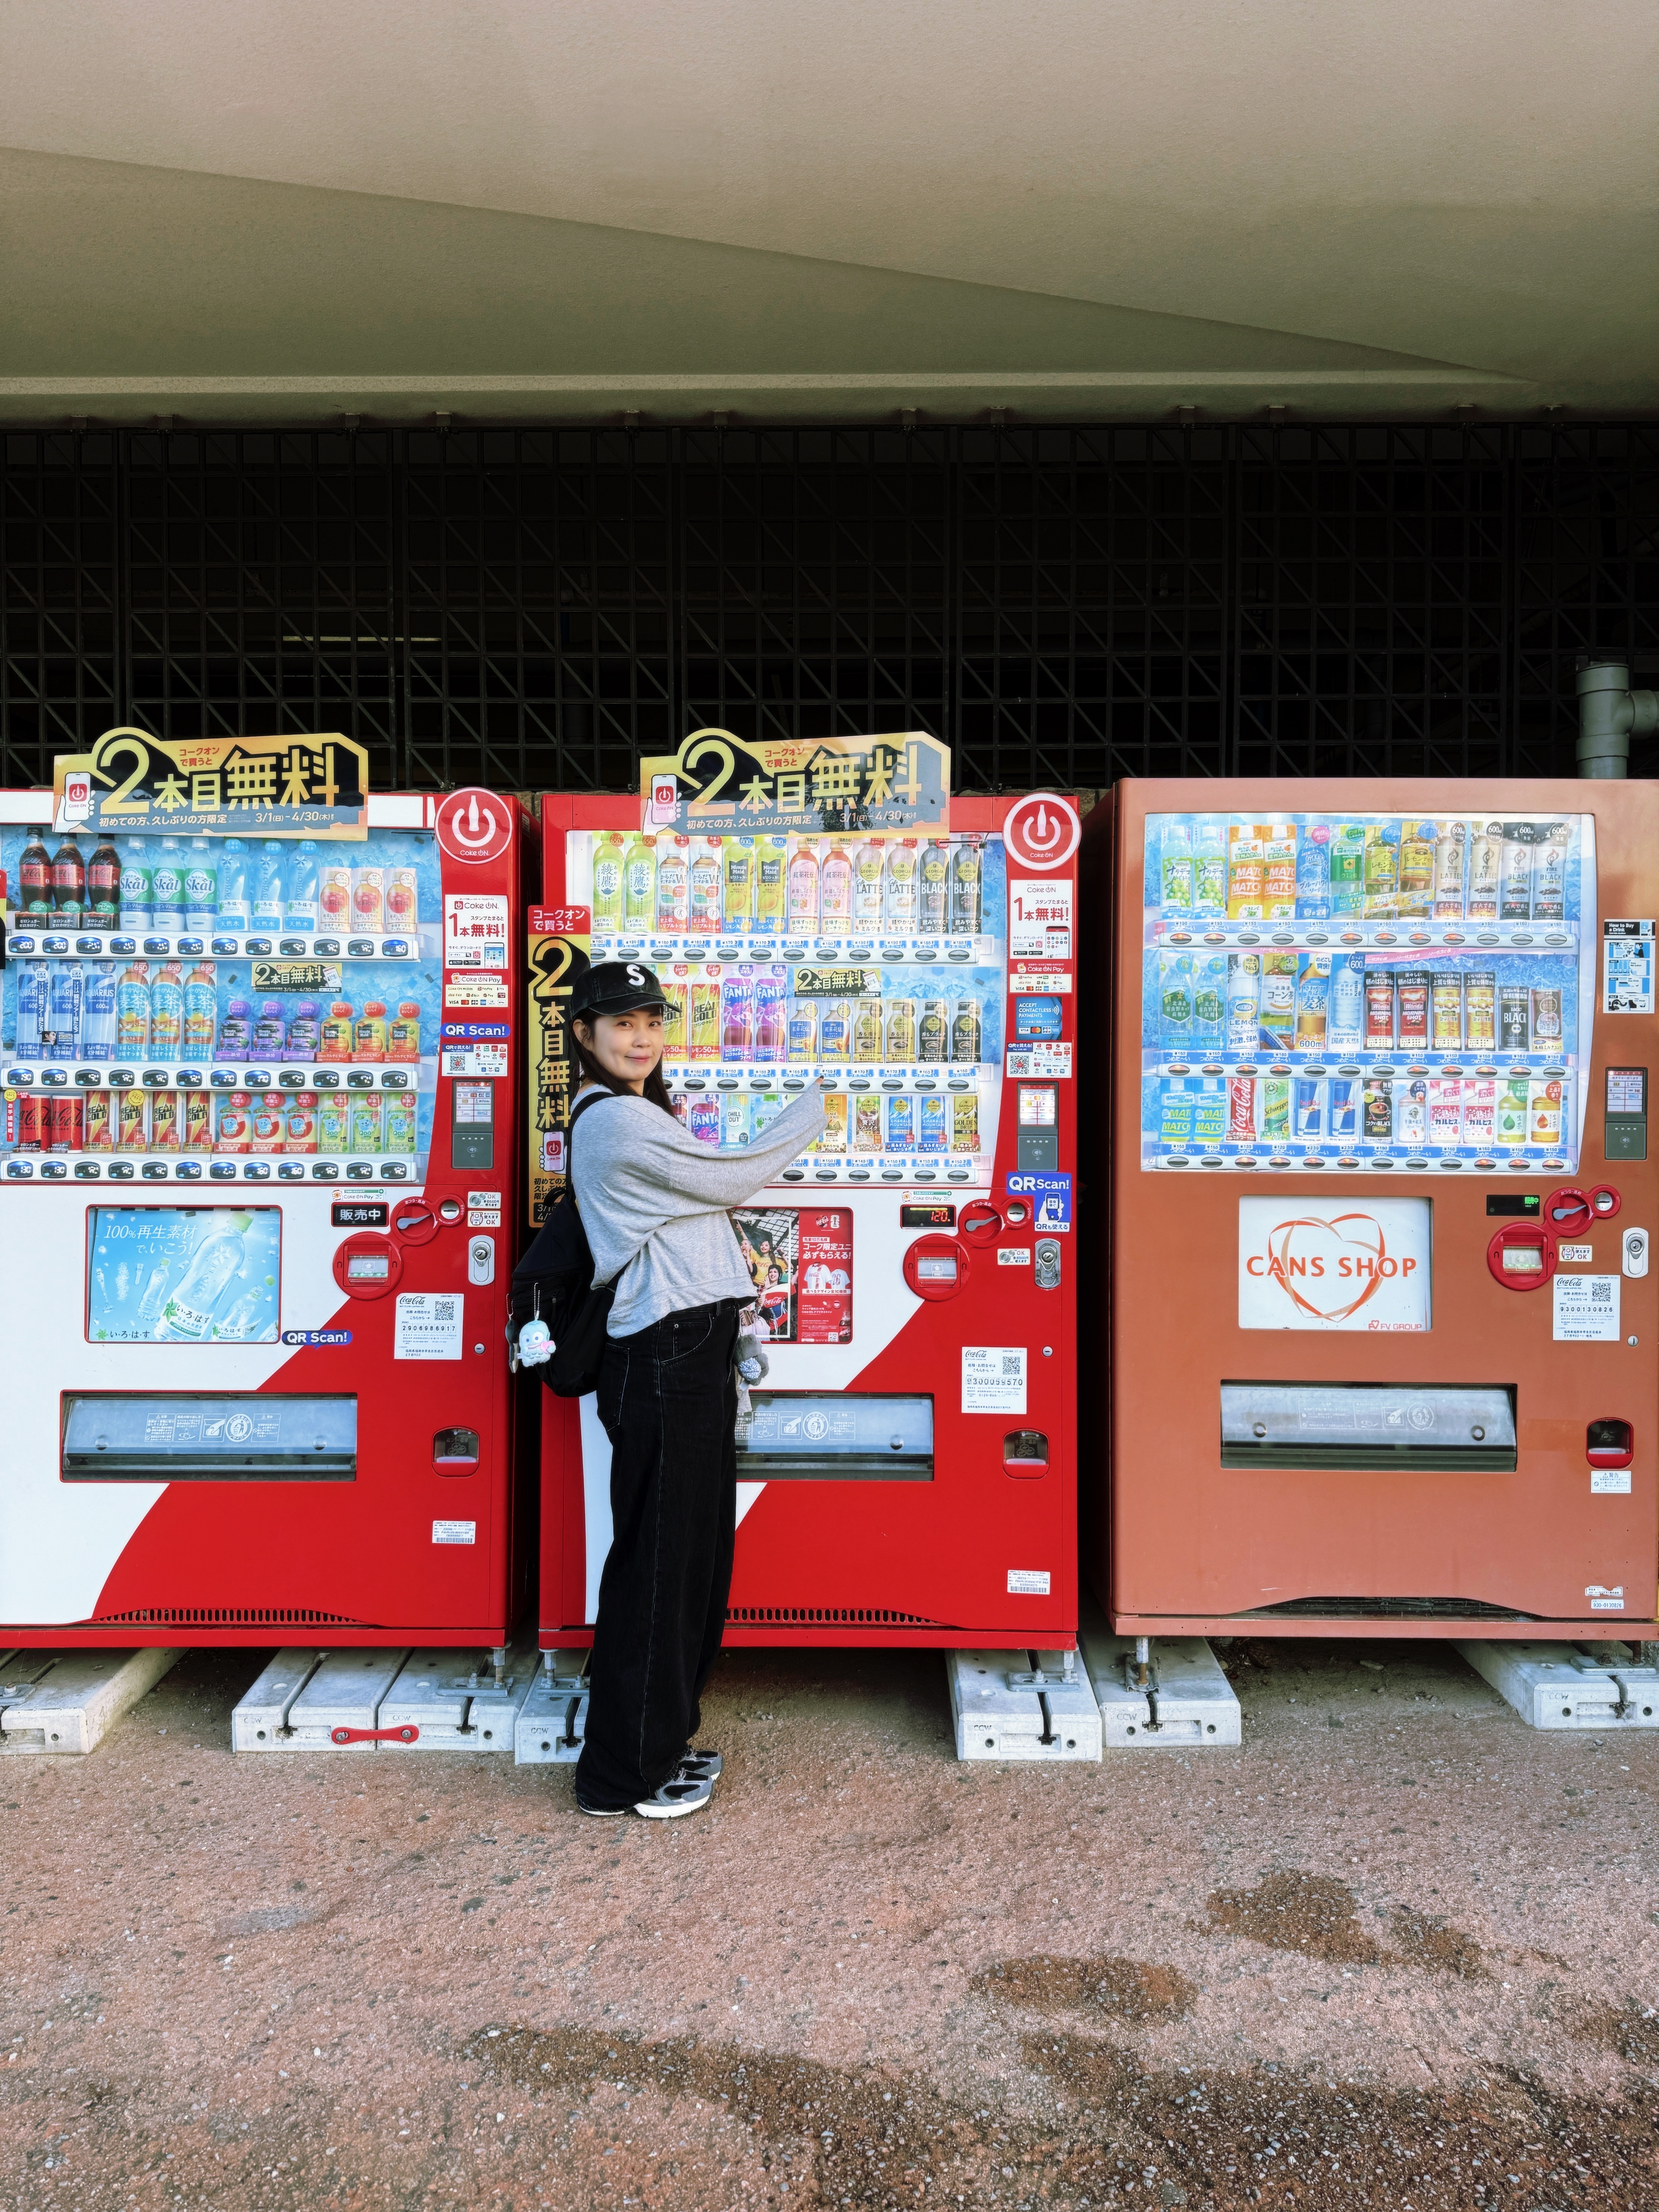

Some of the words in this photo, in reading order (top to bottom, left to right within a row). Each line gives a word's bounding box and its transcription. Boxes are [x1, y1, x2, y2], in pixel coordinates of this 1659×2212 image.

[179, 747, 220, 756] コークオン
[764, 747, 804, 758] コークオン
[180, 757, 213, 767] で買うと
[765, 758, 798, 769] で買うと
[100, 738, 340, 815] 2本目無料
[686, 740, 921, 817] 2本目無料
[99, 814, 227, 827] 初めての方、久しぶりの方限定
[686, 814, 812, 830] 初めての方、久しぶりの方限定
[601, 863, 613, 888] 綾鷹
[634, 863, 646, 888] 綾鷹
[120, 877, 145, 891] Skål
[154, 877, 179, 891] Skål
[186, 877, 213, 891] Skål
[856, 883, 883, 895] LATTE
[889, 883, 915, 895] LATTE
[921, 882, 948, 895] BLACK
[953, 882, 981, 895] BLACK
[533, 910, 585, 920] コークオン
[1014, 897, 1069, 921] 1本無料!
[448, 913, 505, 938] 1本無料!
[533, 921, 574, 931] で買うと
[255, 963, 322, 986] 2本目無料
[627, 964, 646, 986] S
[724, 984, 752, 998] FANTA
[757, 984, 785, 998] FANTA
[1267, 991, 1294, 1001] コーン茶
[119, 995, 148, 1009] 麦茶
[152, 995, 181, 1009] 麦茶
[185, 995, 214, 1009] 麦茶
[1504, 1012, 1527, 1024] BLACK
[445, 1025, 465, 1036] QR
[469, 1025, 505, 1036] Scan!
[1229, 1036, 1257, 1045] 刺激、強め
[87, 1104, 107, 1113] REAL
[120, 1104, 141, 1113] REAL
[153, 1104, 175, 1113] REAL
[86, 1111, 107, 1121] GOLD
[119, 1111, 141, 1121] GOLD
[153, 1111, 175, 1121] GOLD
[692, 1112, 719, 1125] FANTA
[1516, 1115, 1523, 1130] 生茶
[1009, 1176, 1036, 1190] QR
[1037, 1180, 1069, 1189] Scan!
[340, 1208, 381, 1221] 販売中
[103, 1224, 197, 1240] 100%再生素材
[136, 1241, 194, 1255] で、いこう!
[803, 1251, 851, 1259] 必ずもらえる!
[1246, 1256, 1325, 1277] CANS
[1338, 1257, 1417, 1278] SHOP
[287, 1333, 307, 1343] QR
[310, 1332, 348, 1343] Scan!
